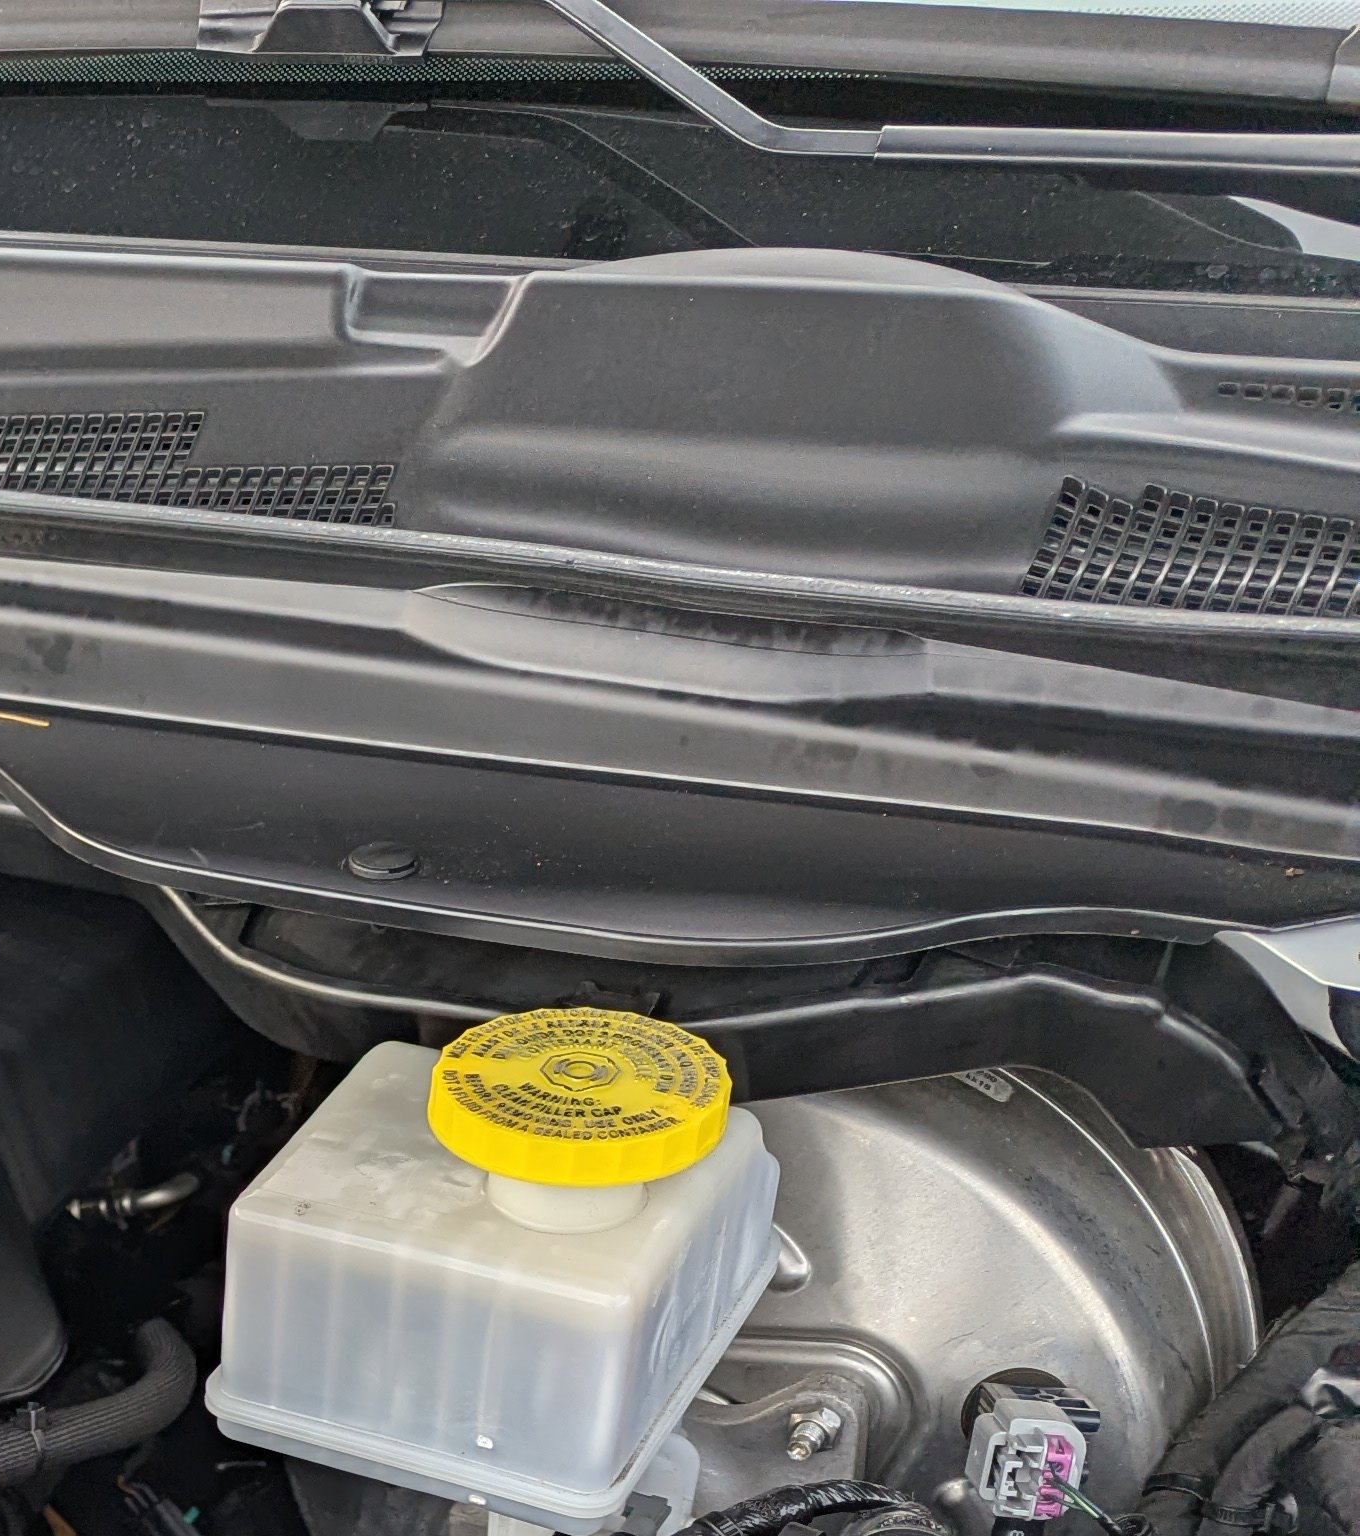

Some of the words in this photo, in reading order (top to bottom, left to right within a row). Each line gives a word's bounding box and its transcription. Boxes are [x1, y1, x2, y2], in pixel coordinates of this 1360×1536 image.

[452, 1090, 483, 1112] FLUID
[478, 1109, 519, 1130] FROM
[518, 1122, 529, 1133] A
[533, 1127, 593, 1141] SEALED
[464, 1073, 497, 1102] BEFORE
[584, 1118, 616, 1129] USE
[622, 1109, 661, 1126] ONLY
[492, 1084, 532, 1108] CLEAN
[531, 1103, 586, 1118] FILLER
[591, 1106, 622, 1118] CAP
[518, 1082, 601, 1107] WARNING:
